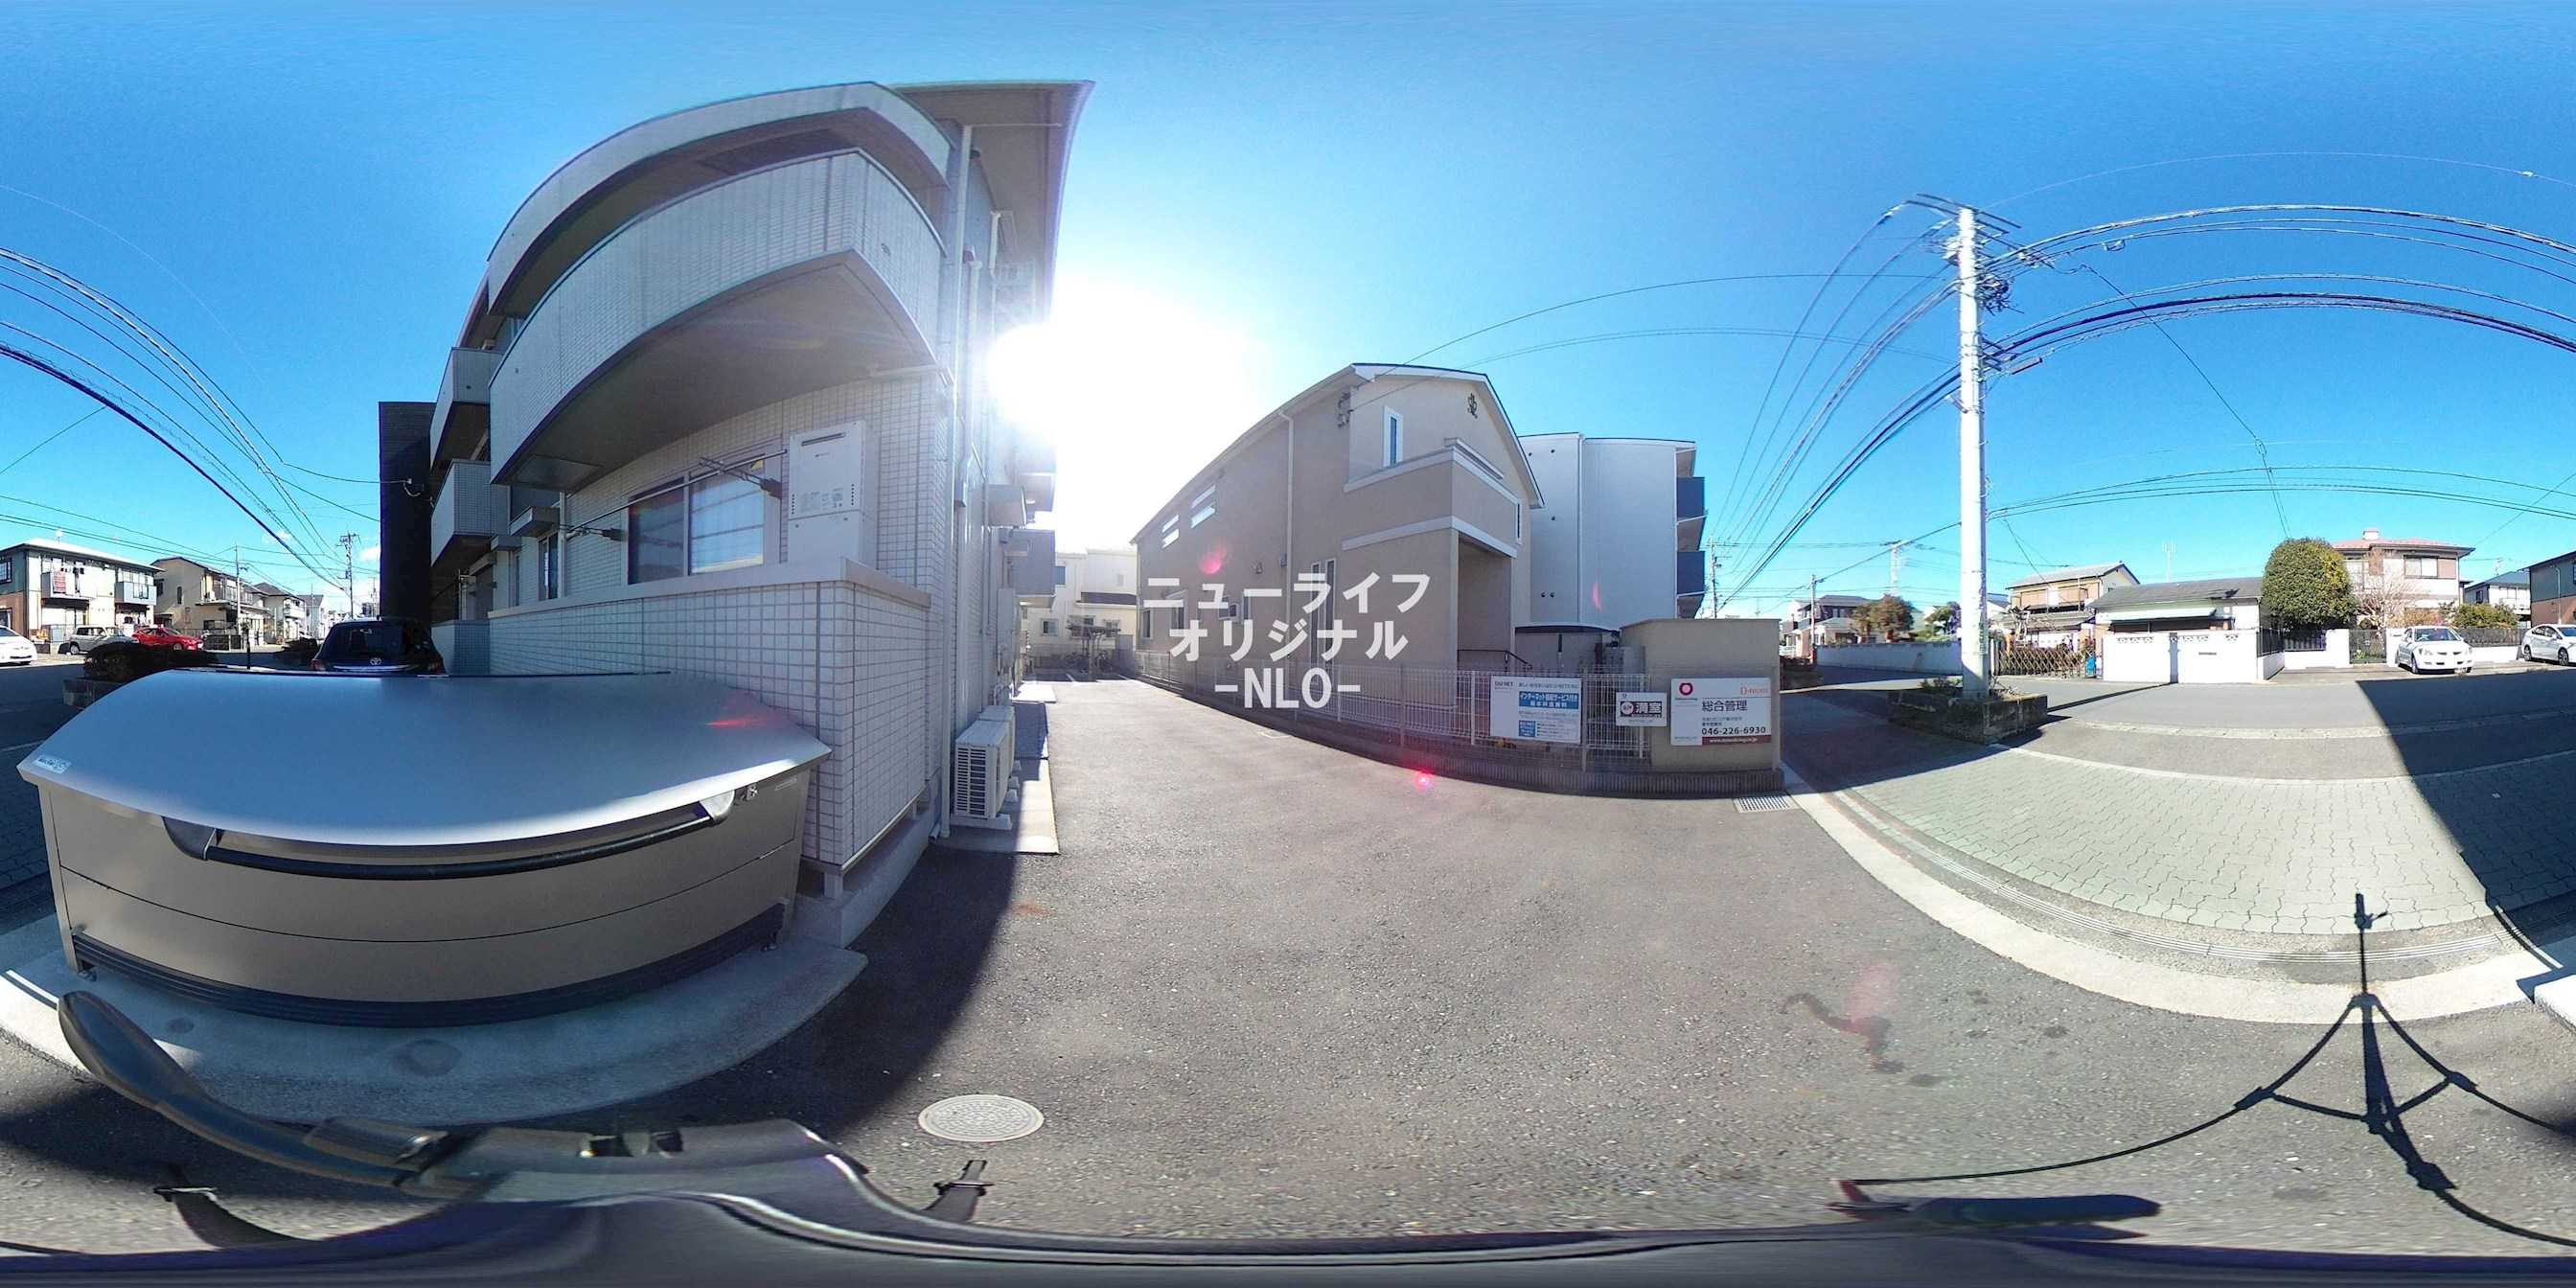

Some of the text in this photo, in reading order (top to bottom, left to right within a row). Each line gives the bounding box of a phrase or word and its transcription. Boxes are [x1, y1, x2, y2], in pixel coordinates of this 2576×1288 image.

[1701, 700, 1748, 712] 総合管理
[1701, 726, 1766, 736] 046-226-6930
